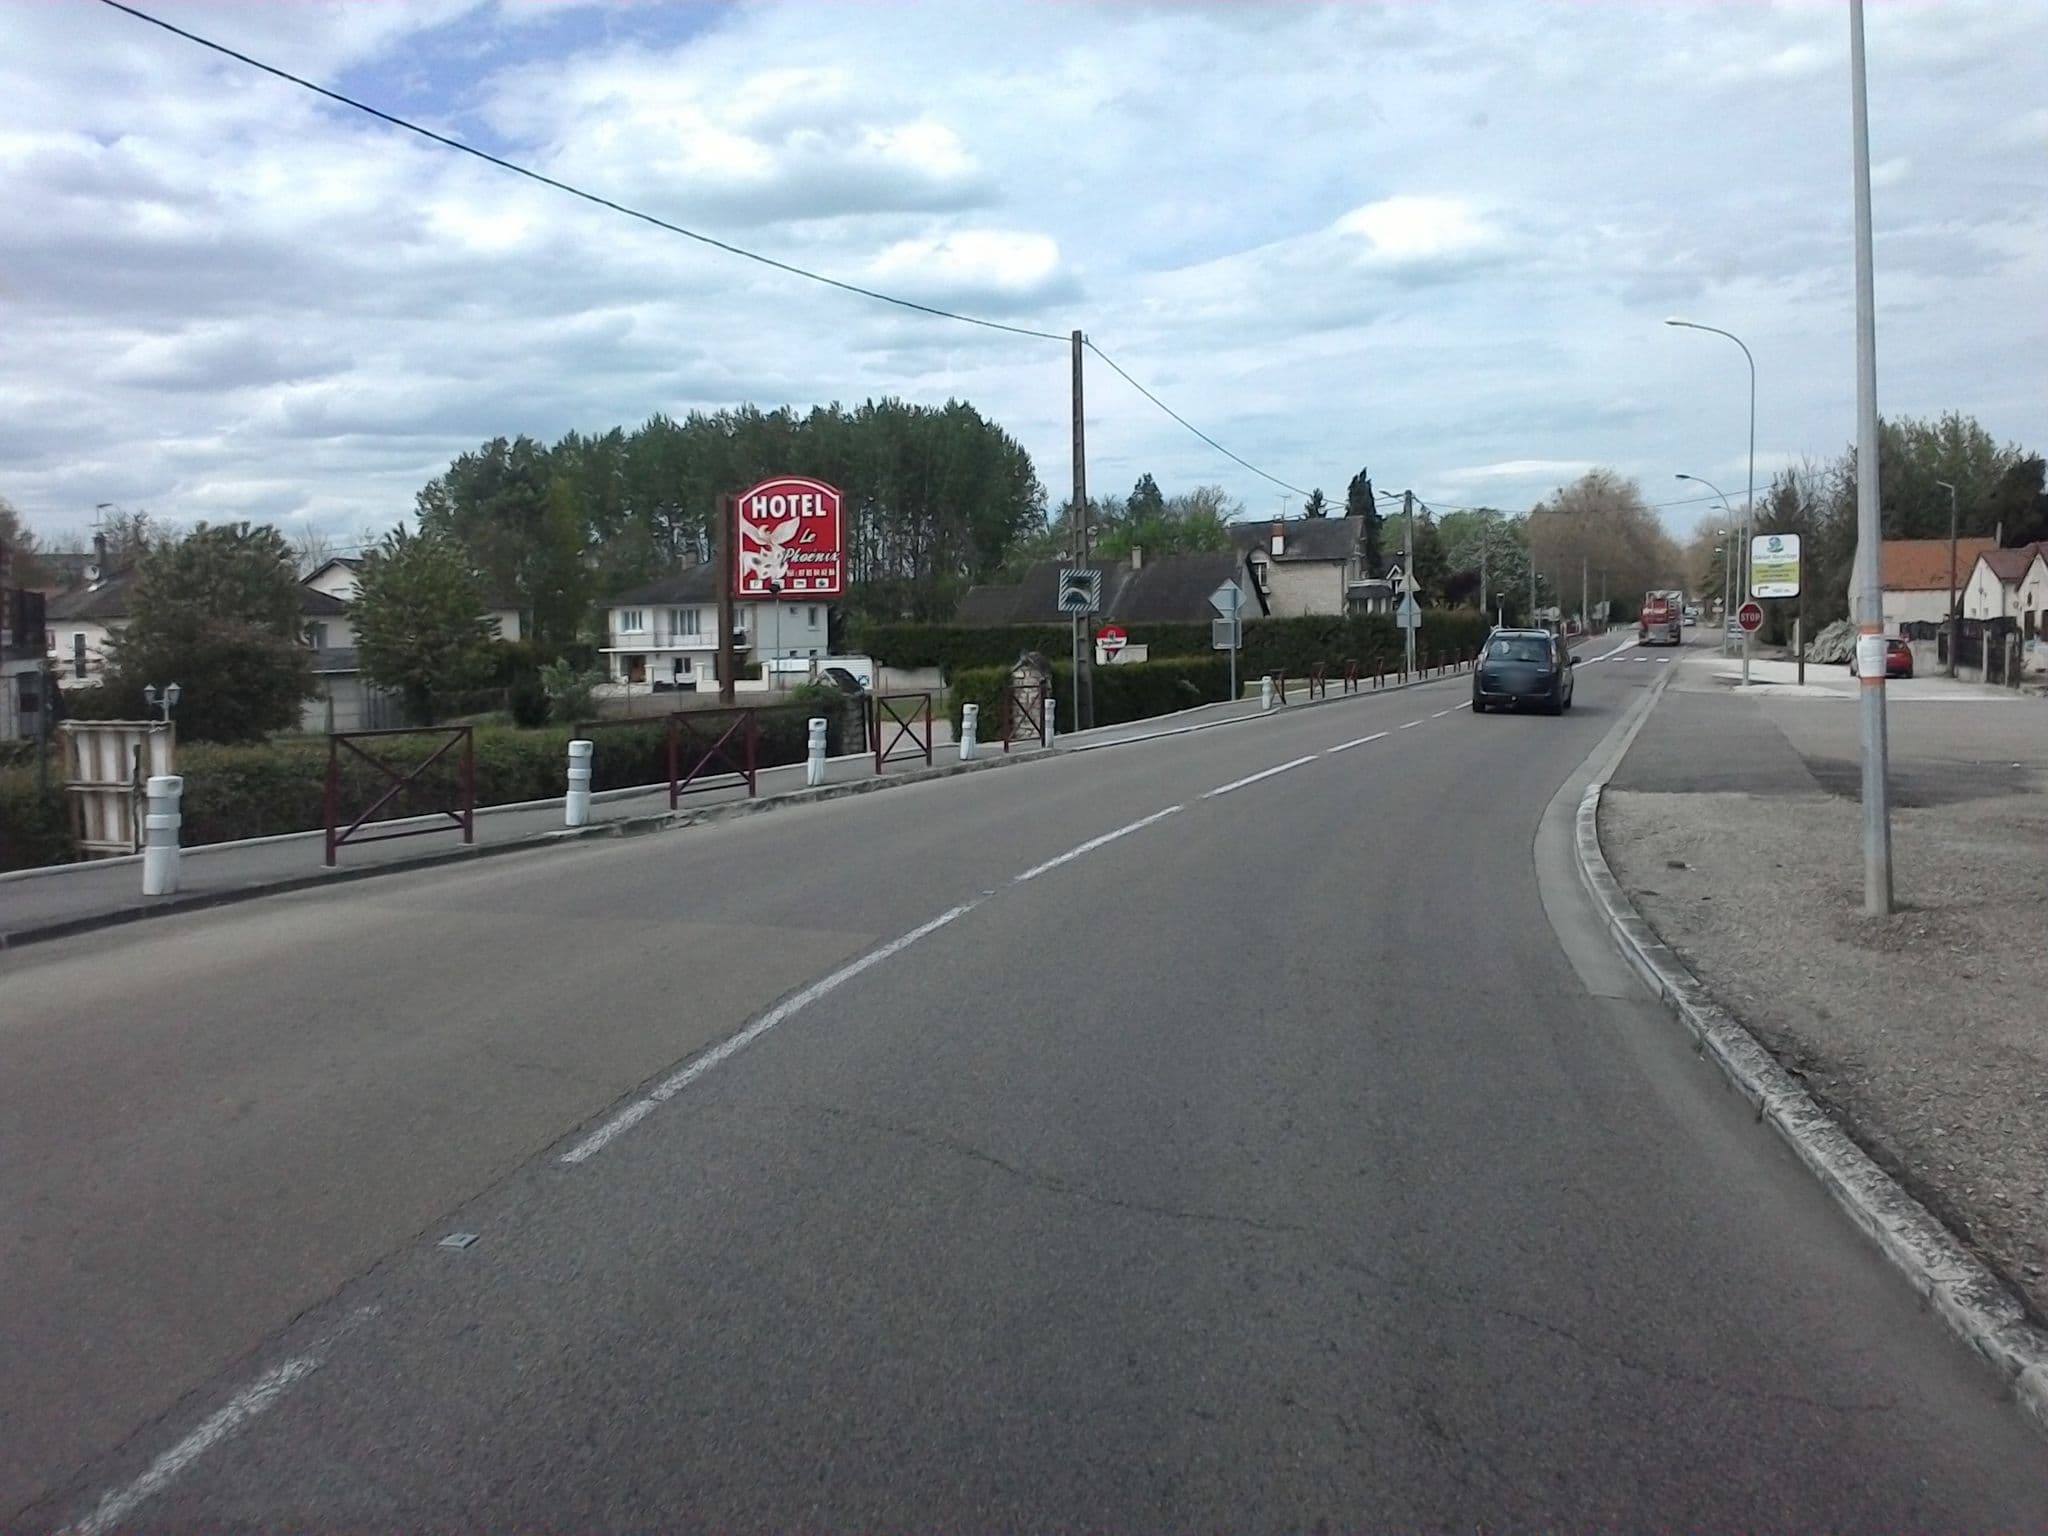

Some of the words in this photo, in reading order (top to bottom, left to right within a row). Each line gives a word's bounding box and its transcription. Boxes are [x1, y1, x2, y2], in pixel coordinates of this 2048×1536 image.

[752, 494, 827, 519] HOTEL
[800, 528, 816, 544] Le
[1741, 612, 1760, 622] STOP
